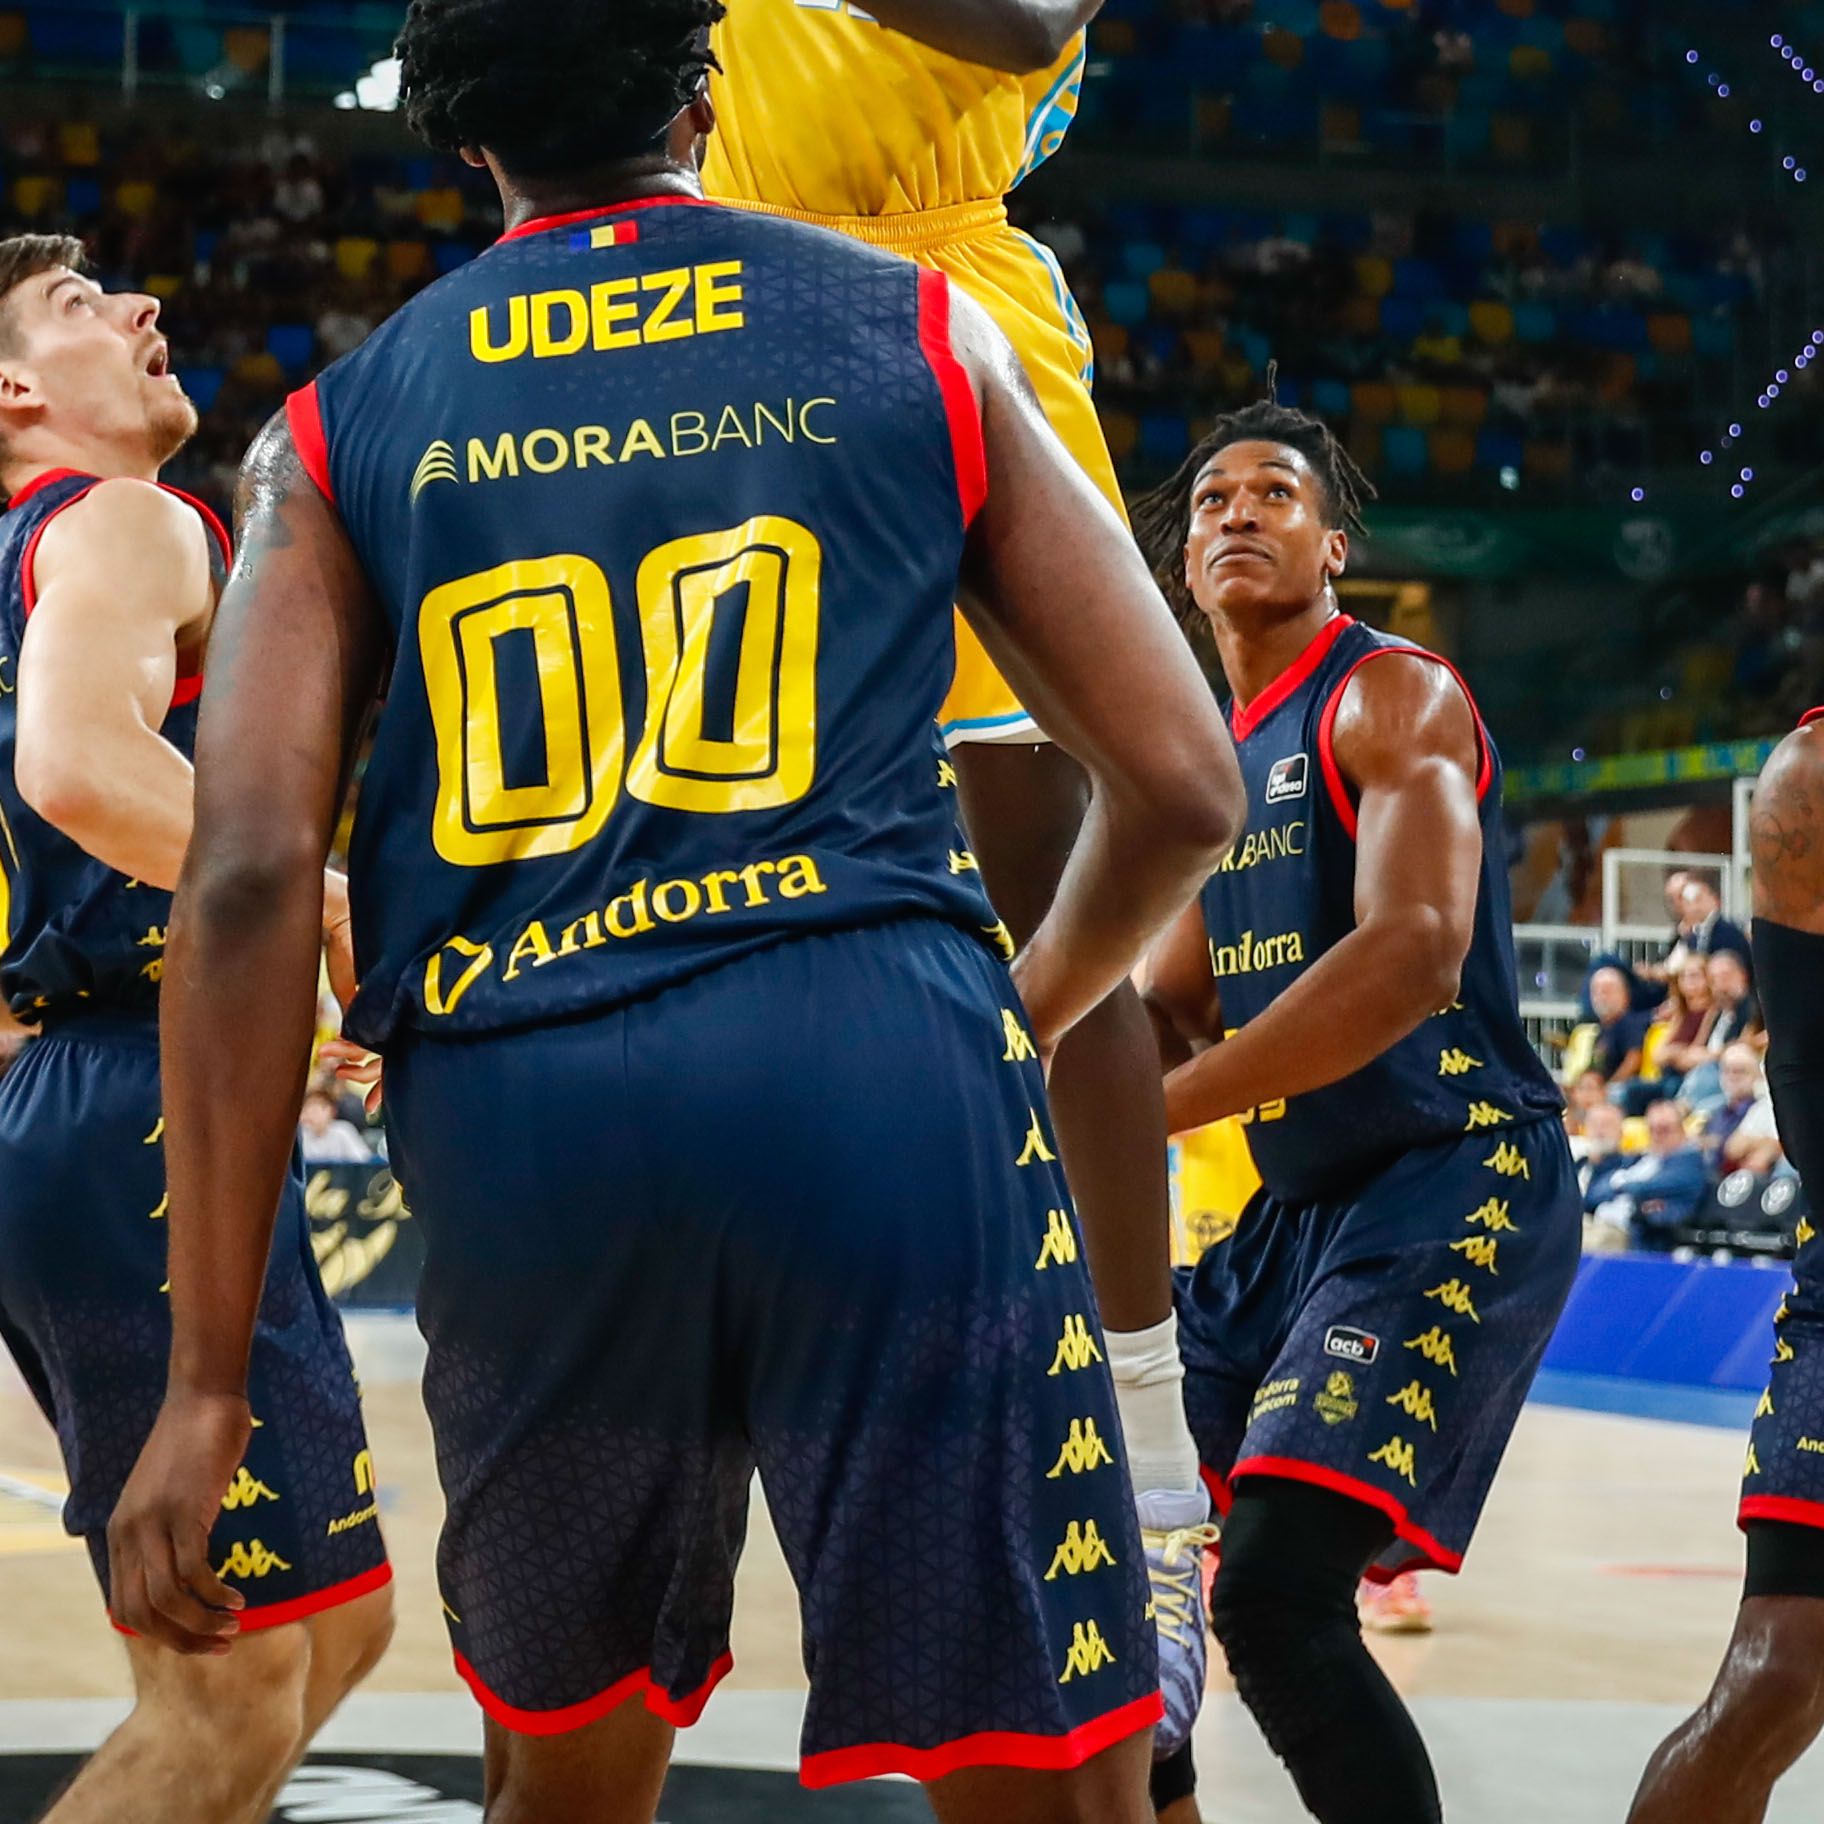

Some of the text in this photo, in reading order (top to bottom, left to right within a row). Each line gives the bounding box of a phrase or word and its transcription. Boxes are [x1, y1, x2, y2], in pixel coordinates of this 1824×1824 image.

[469, 260, 745, 363] UDEZE
[466, 397, 837, 484] MORABANC
[418, 515, 821, 866] 00
[502, 853, 827, 982] Andorra
[1329, 1337, 1365, 1357] acb
